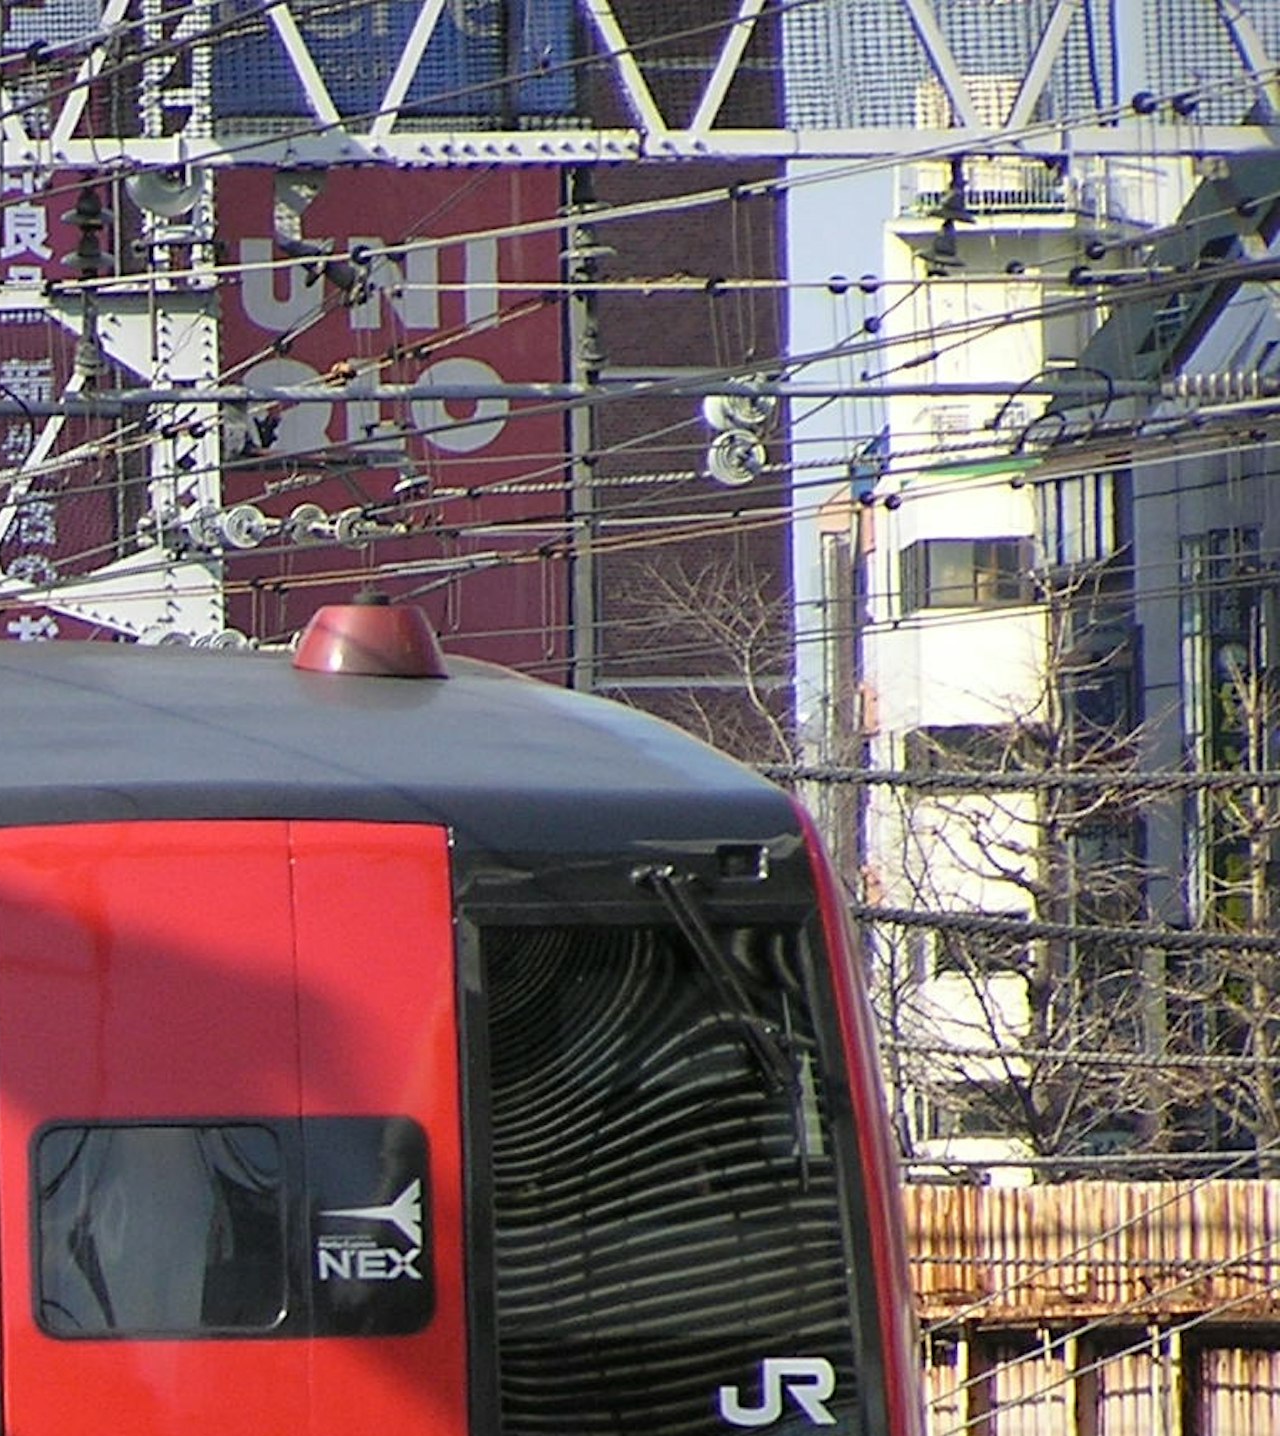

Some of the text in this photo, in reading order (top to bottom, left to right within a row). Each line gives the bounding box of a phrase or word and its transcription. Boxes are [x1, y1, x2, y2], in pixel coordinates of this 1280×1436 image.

[240, 237, 499, 332] UNI
[242, 358, 510, 453] QLO
[719, 1357, 838, 1426] JR
